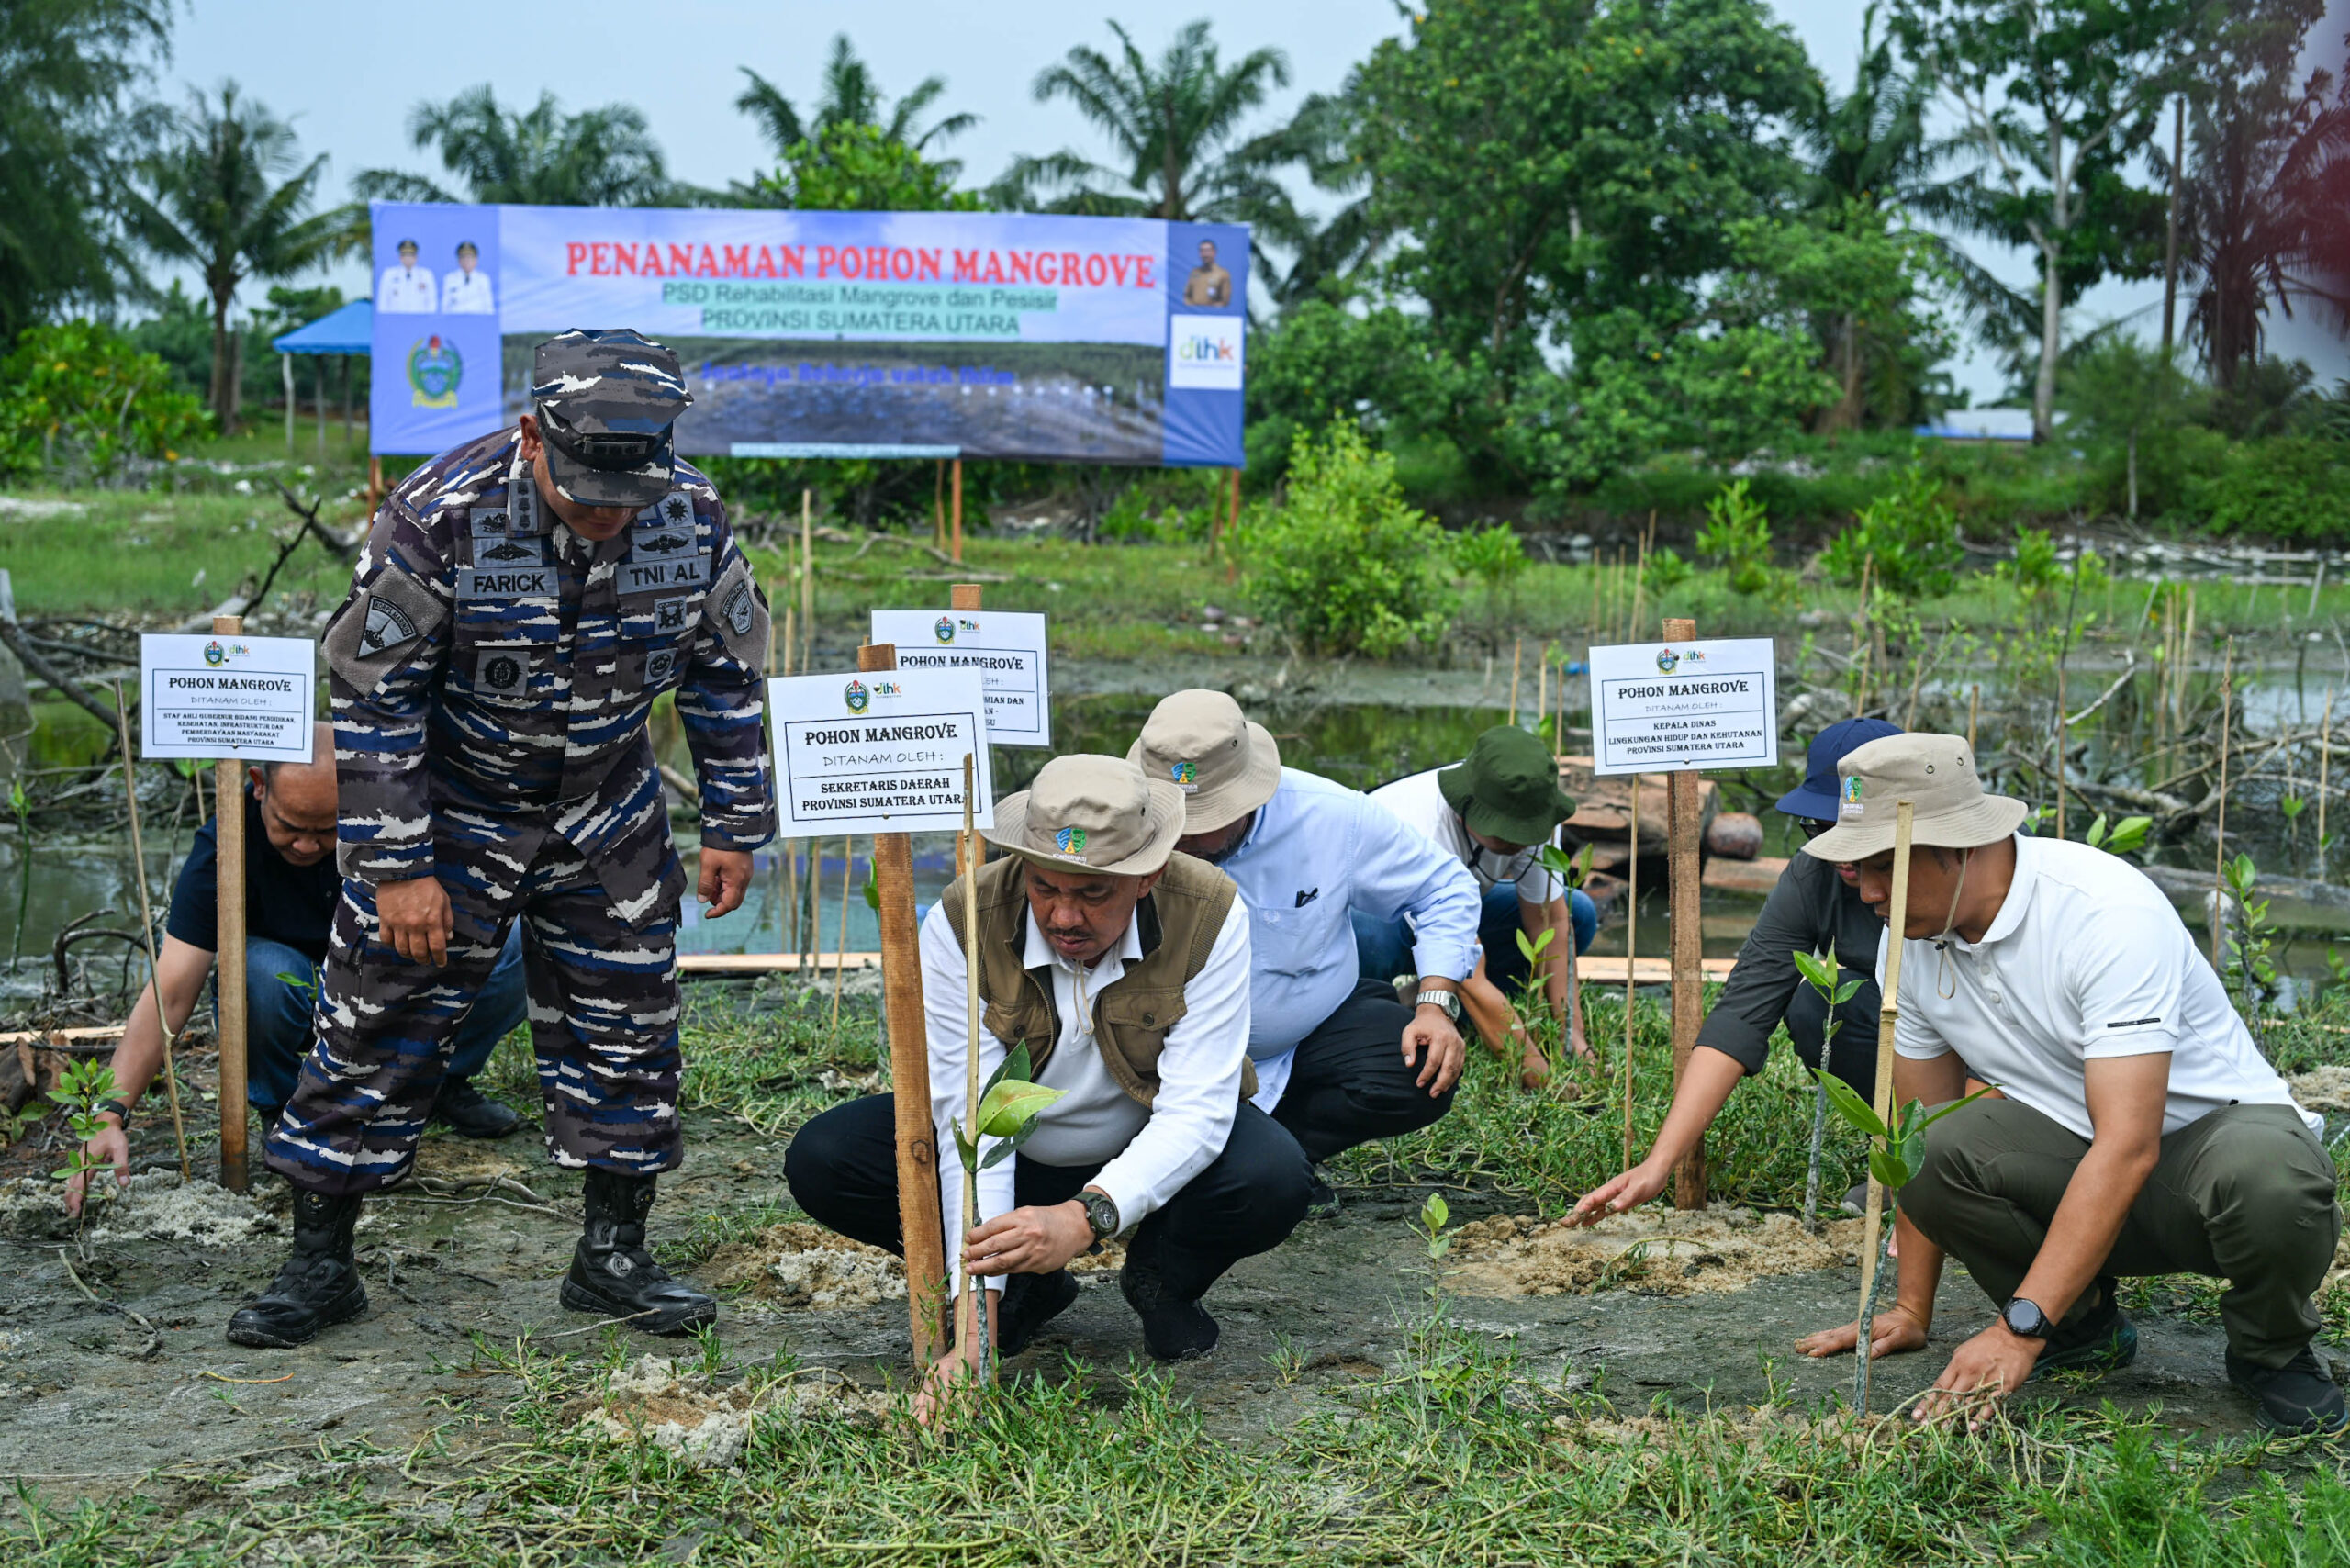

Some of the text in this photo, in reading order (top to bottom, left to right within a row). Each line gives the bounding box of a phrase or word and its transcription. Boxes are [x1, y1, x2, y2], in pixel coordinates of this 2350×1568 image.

[566, 241, 1157, 288] PENANAMAN POHON MANGROVE
[663, 282, 1058, 310] PSD Rehabilitasi Mangrove dan Pesisir
[702, 308, 1020, 334] PROVINSI SUMATERA UTARA
[630, 564, 700, 586] TNI AL
[474, 573, 545, 593] FARICK
[375, 600, 393, 615] KORPS
[900, 656, 1024, 670] POHON MANGROVE
[169, 677, 292, 692] POHON MANGROVE
[1618, 679, 1750, 699] POHON MANGROVE
[191, 696, 239, 705] DITANAM
[241, 698, 267, 706] OLEH
[1007, 697, 1024, 705] DAN
[1645, 703, 1689, 712] DITANAM
[1653, 720, 1717, 730] KEPALA DINAS
[218, 737, 252, 745] SUMATERA
[805, 722, 957, 745] POHON MANGROVE
[1608, 730, 1762, 745] LINGKUNGAN HIDUP DAN KEHUTANAN
[1627, 741, 1745, 754] PROVINSI SUMATERA UTARA
[823, 753, 892, 767] DITANAM
[897, 751, 935, 763] OLEH
[821, 778, 950, 794] SEKRETARIS DAERAH
[802, 797, 857, 812] PROVINSI
[859, 795, 925, 808] SUMATERA
